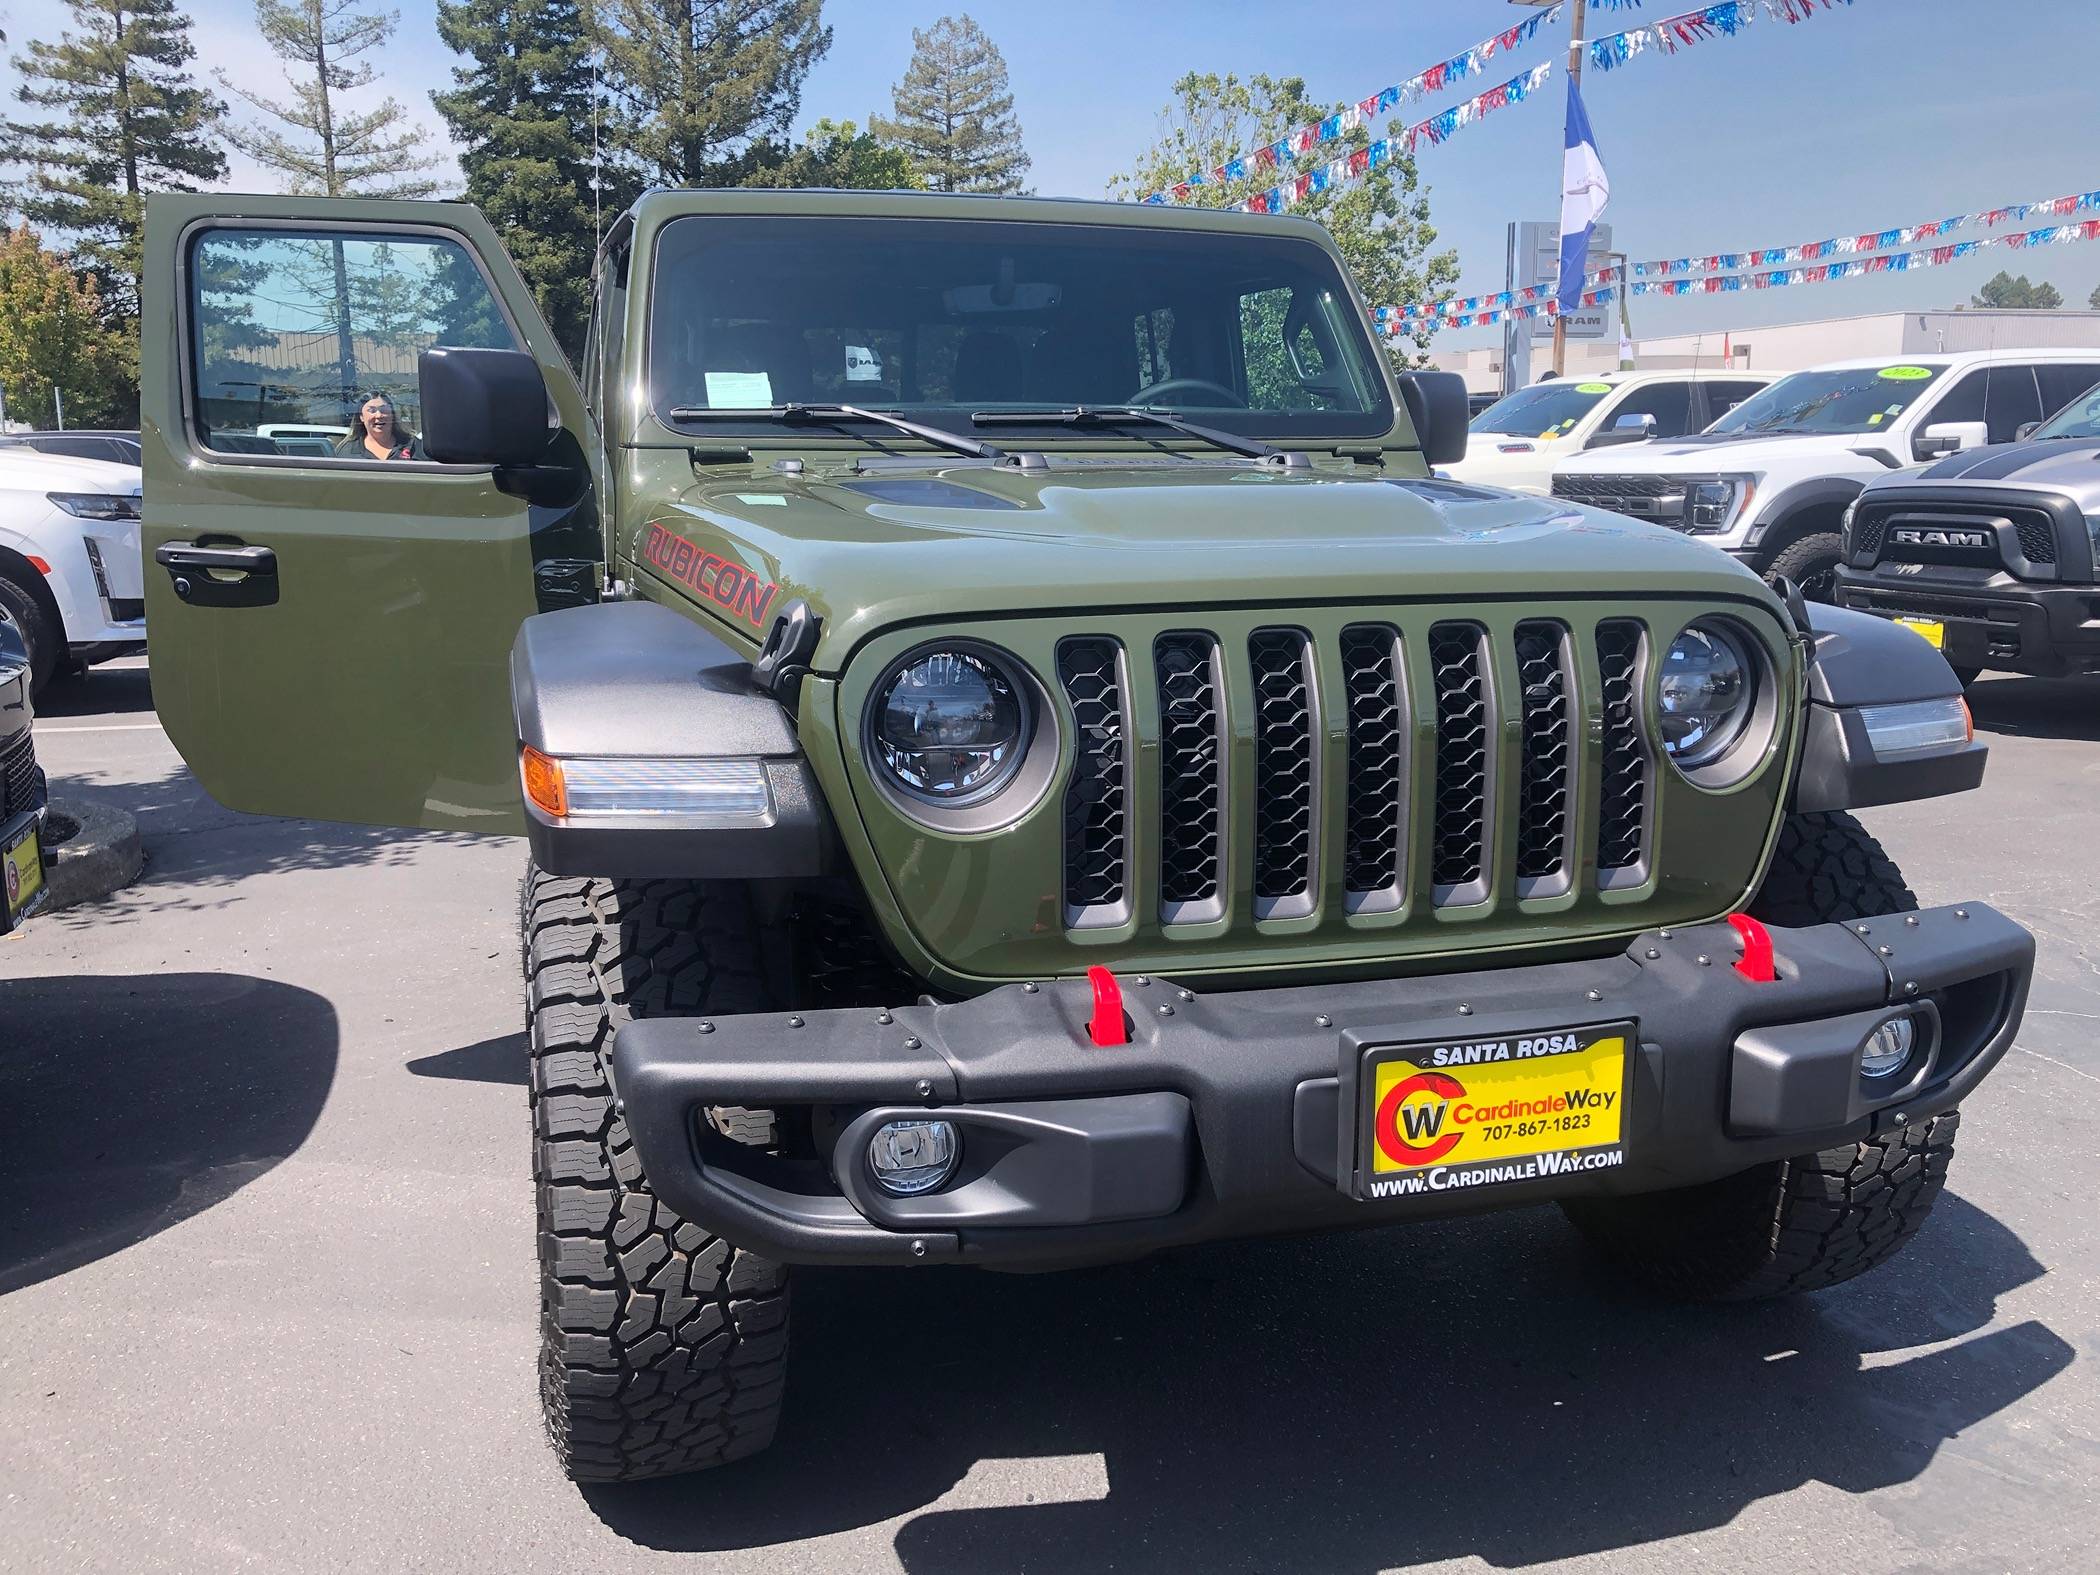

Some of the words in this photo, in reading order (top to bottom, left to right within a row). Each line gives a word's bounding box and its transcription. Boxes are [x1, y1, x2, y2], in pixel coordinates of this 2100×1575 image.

[1566, 317, 1601, 325] RAM
[1896, 531, 1983, 546] RAM
[644, 523, 778, 628] RUBICON
[1432, 1042, 1510, 1067] SANTA
[1517, 1035, 1577, 1057] ROSA
[1453, 1088, 1616, 1125] CardinaleWay
[1483, 1114, 1591, 1142] 707-867-1823
